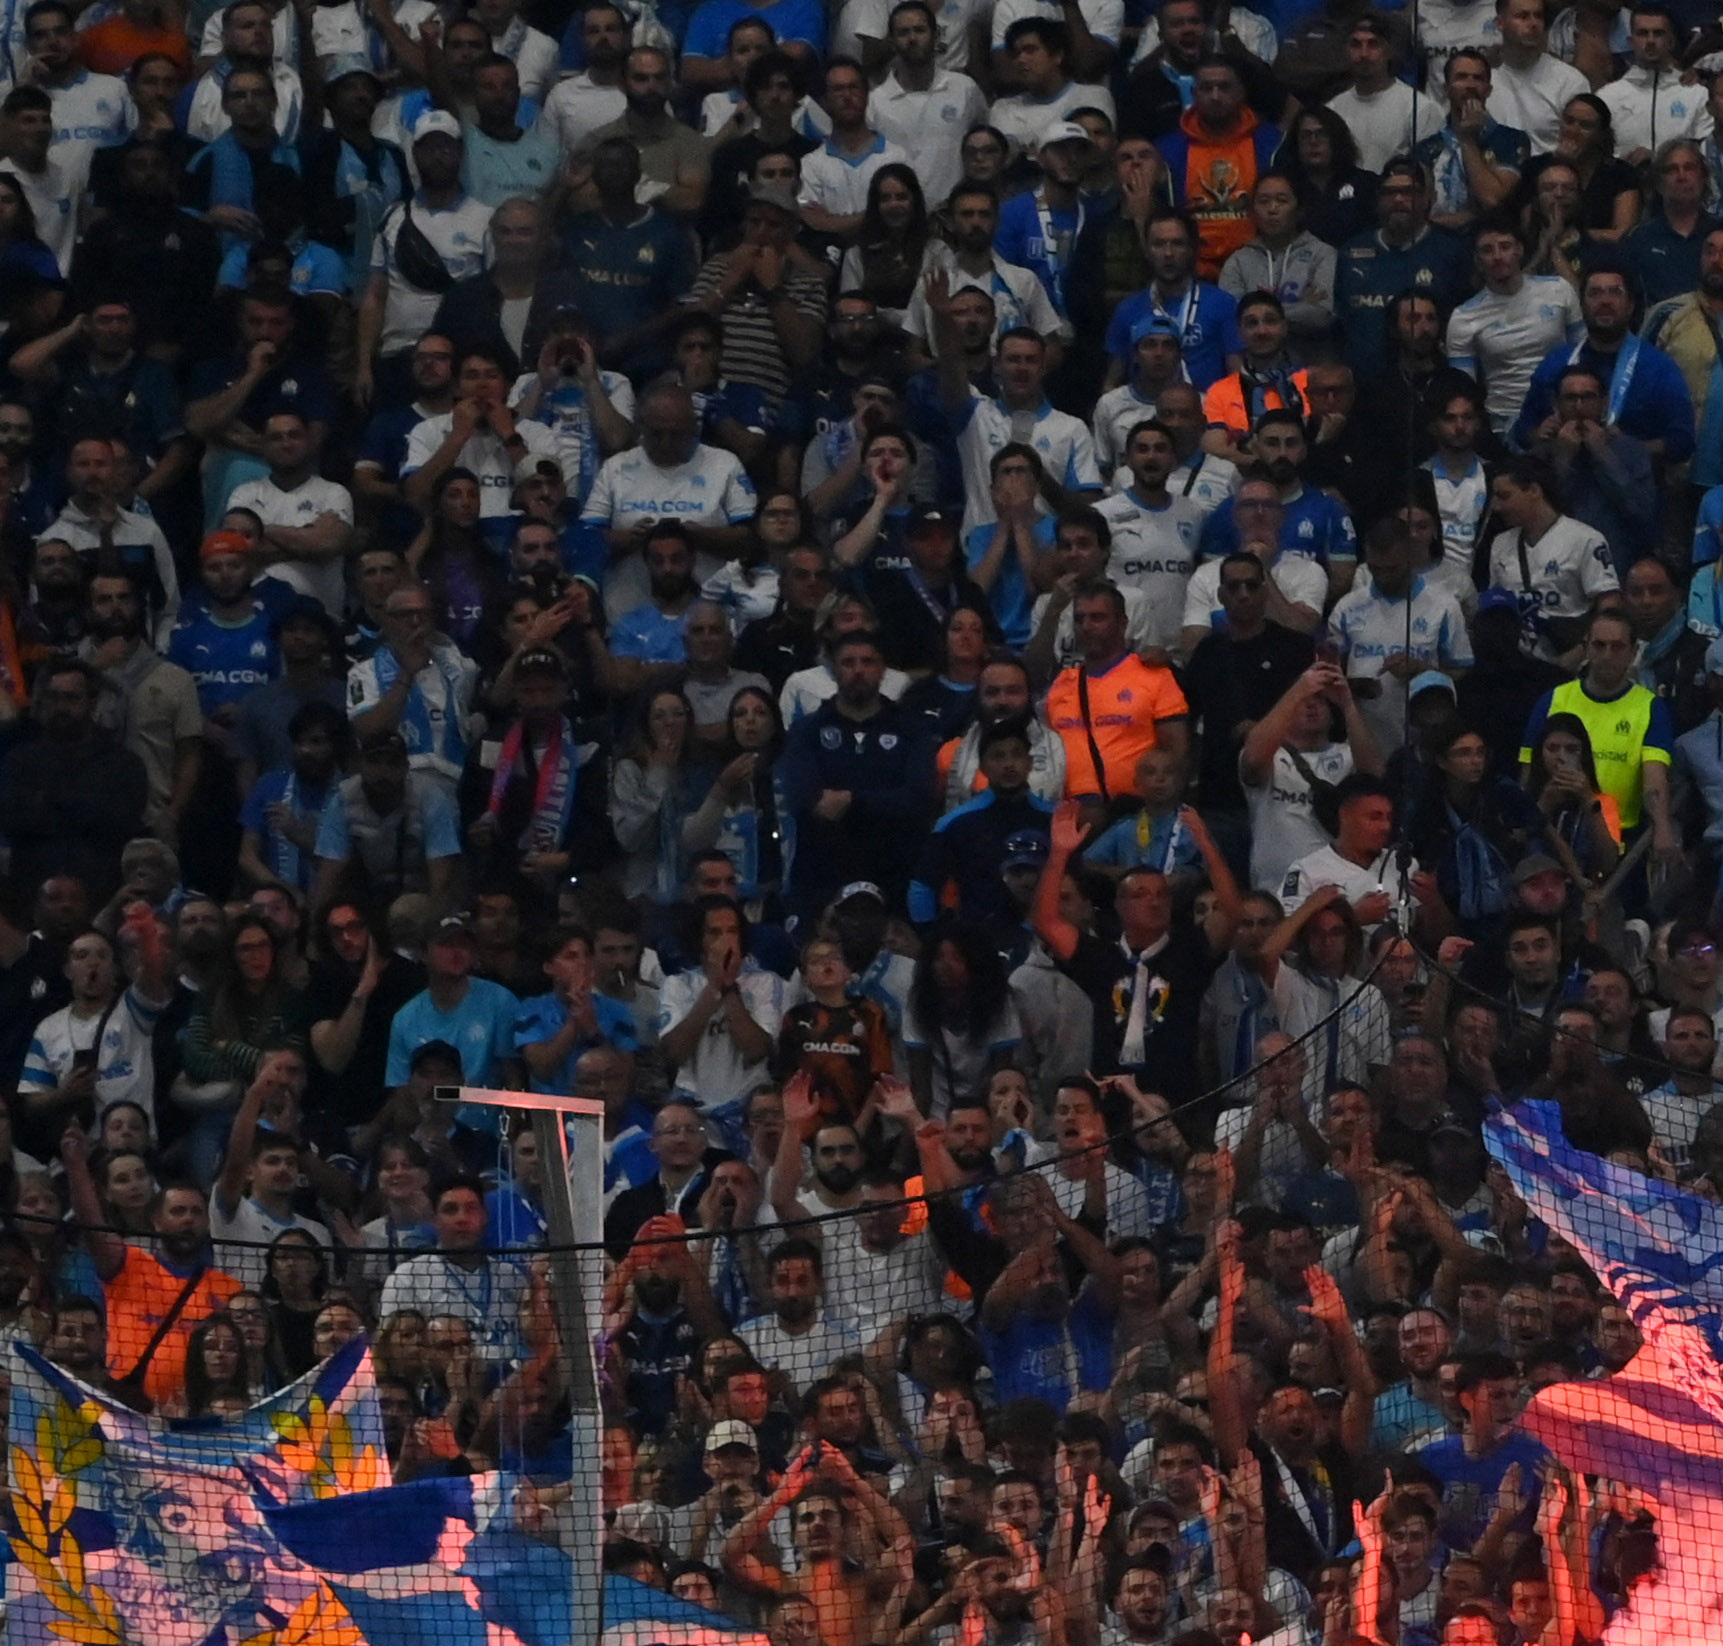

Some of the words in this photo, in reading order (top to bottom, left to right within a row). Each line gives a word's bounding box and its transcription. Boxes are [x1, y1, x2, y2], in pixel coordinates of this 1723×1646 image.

[620, 500, 659, 513] CMA
[661, 500, 704, 513] CGM
[875, 556, 913, 570] CMA
[1124, 561, 1163, 576] CMA
